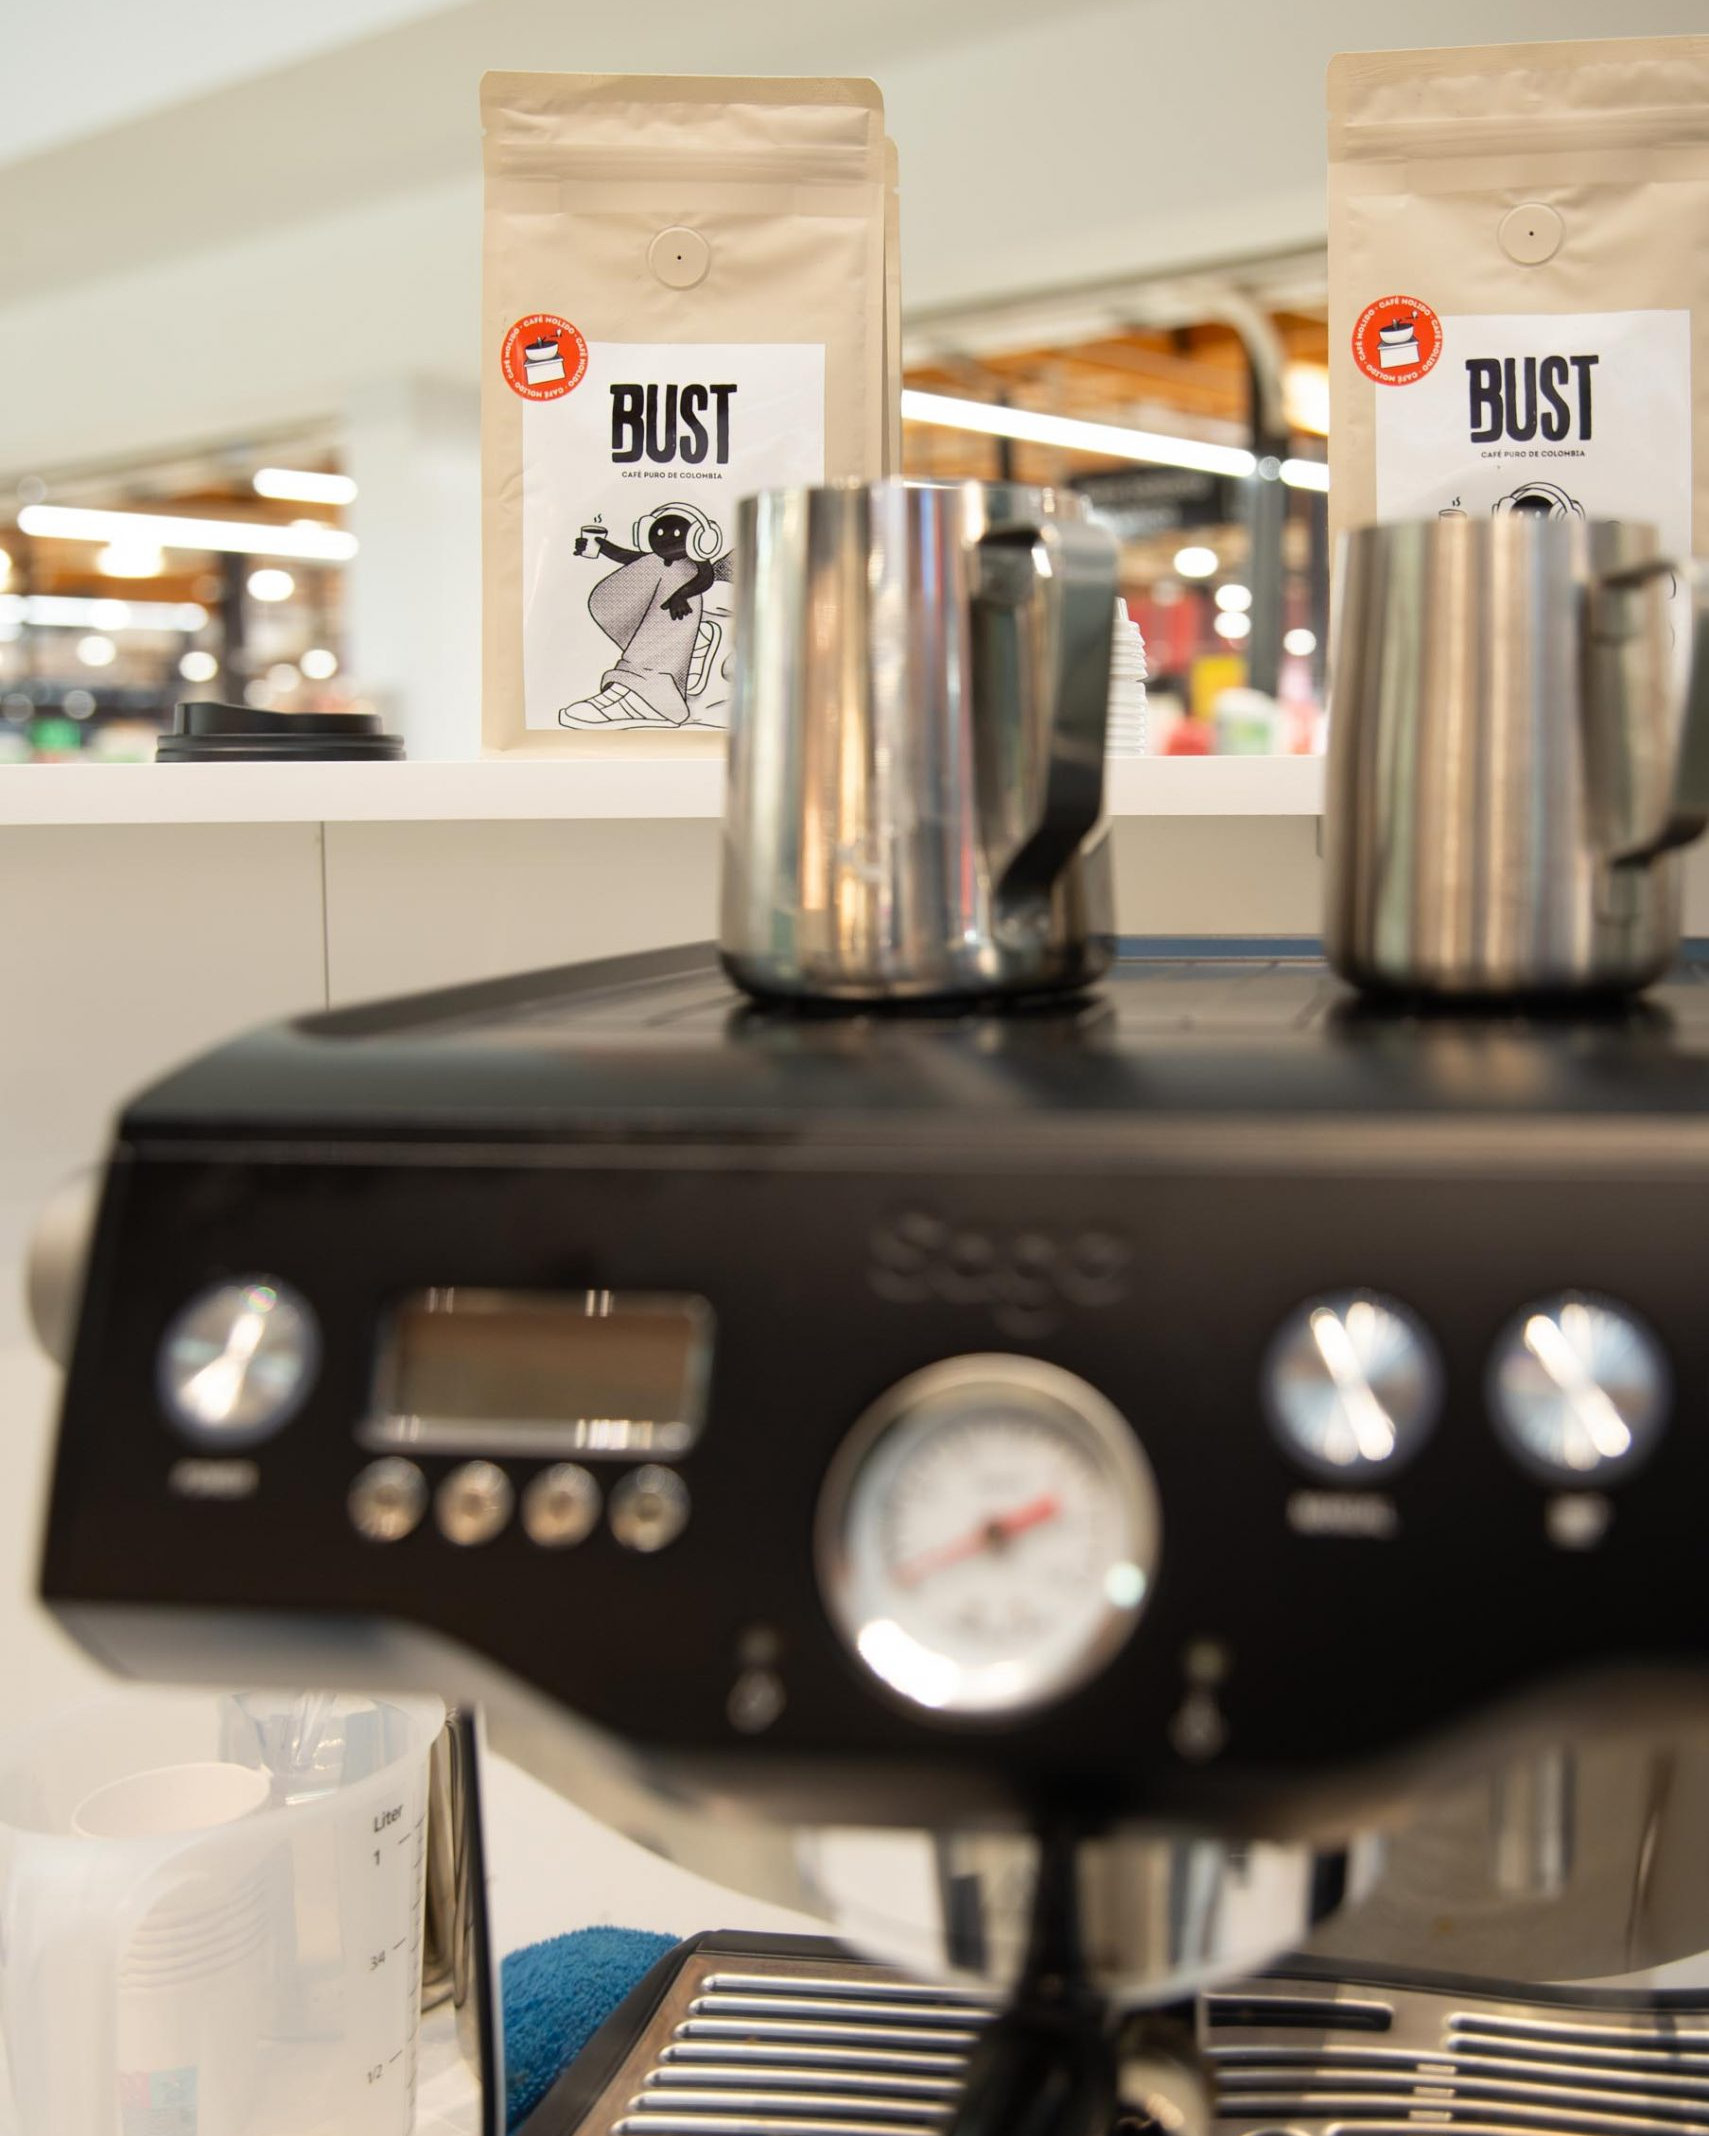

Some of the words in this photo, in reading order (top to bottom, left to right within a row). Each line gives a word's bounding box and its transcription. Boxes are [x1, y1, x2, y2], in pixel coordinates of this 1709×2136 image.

[1379, 296, 1399, 309] CAFÉ
[1401, 298, 1431, 316] MOLIDO
[523, 315, 543, 327] CAFÉ
[545, 317, 575, 334] MOLIDO
[1465, 354, 1599, 443] BUST
[610, 384, 737, 464] BUST
[1481, 449, 1501, 458] CAFÉ
[1504, 450, 1526, 458] PURO
[621, 469, 642, 478] CAFÉ
[644, 471, 666, 479] PURO
[374, 1804, 404, 1833] Liter
[373, 1849, 380, 1866] 1
